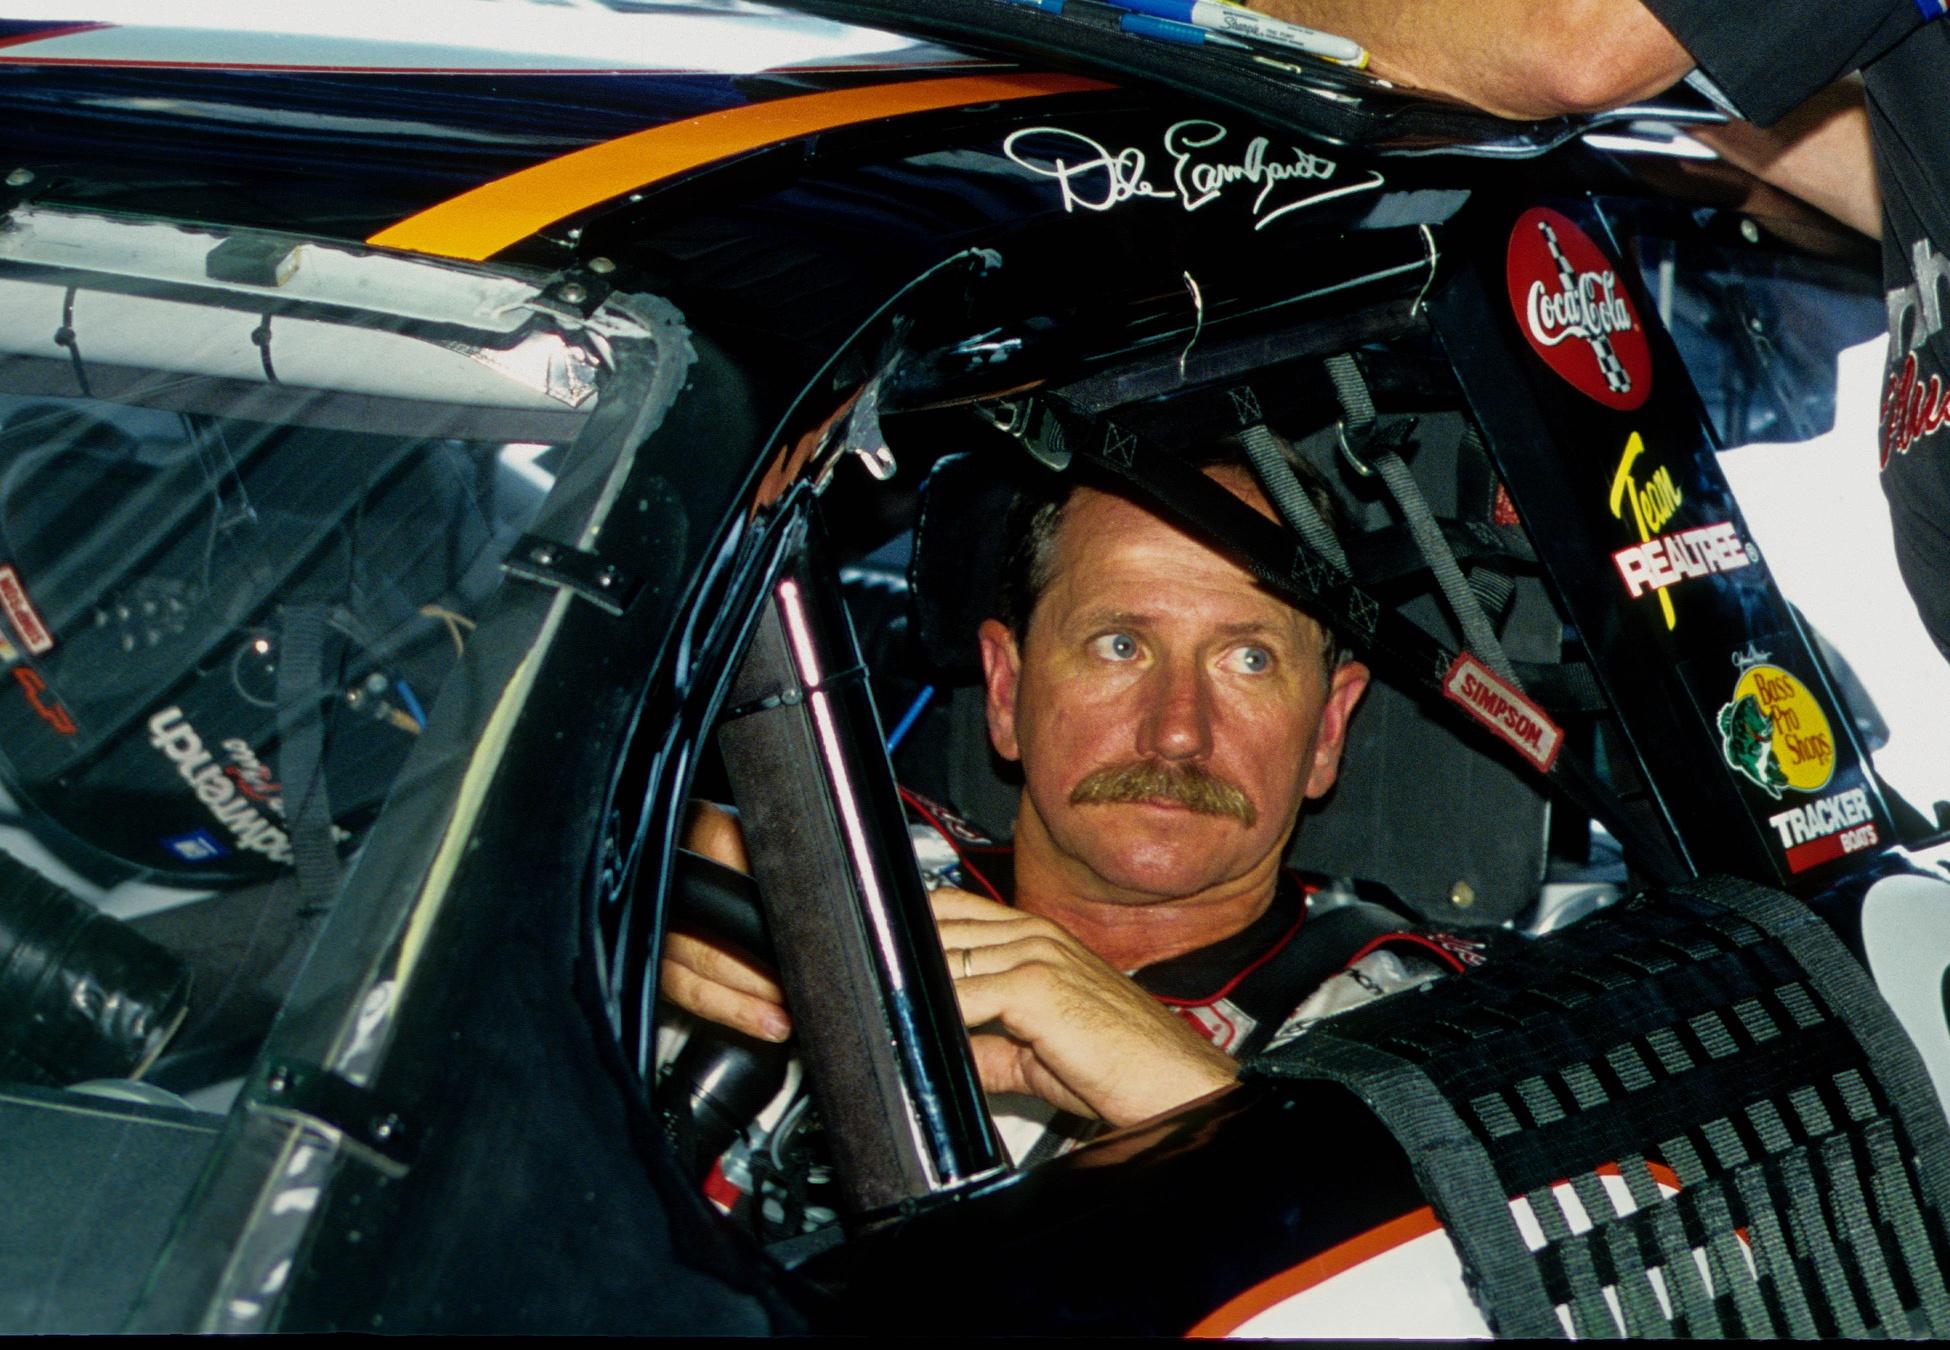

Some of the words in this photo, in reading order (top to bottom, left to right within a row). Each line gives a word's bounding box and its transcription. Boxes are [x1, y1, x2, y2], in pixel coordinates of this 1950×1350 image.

[1610, 431, 1682, 631] Team
[1614, 522, 1750, 598] REALTREE
[1461, 673, 1543, 749] SIMPSON
[1754, 673, 1795, 705] Bass
[1771, 705, 1800, 735] Pro
[1785, 734, 1832, 765] Shops
[1769, 788, 1873, 849] TRACKER
[1840, 825, 1879, 853] BOATS
